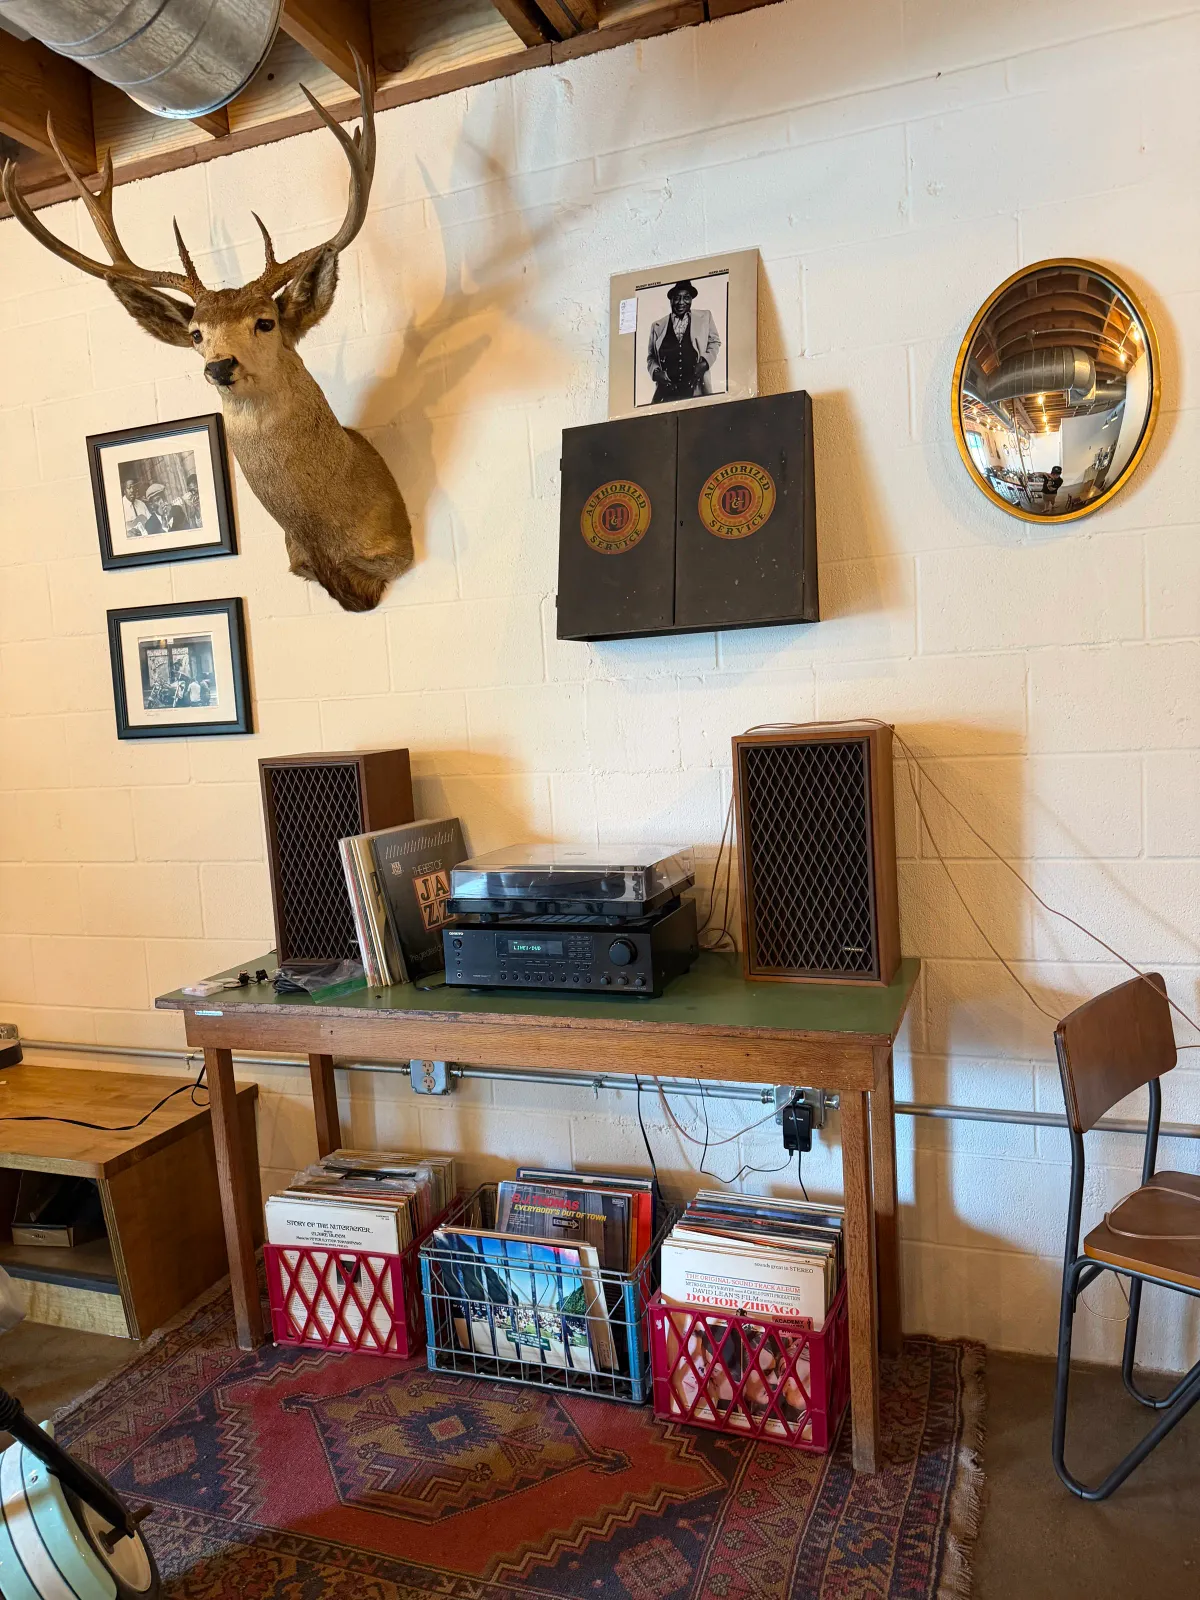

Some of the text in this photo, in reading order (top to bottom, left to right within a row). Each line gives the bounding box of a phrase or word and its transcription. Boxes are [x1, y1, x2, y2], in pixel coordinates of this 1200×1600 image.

[704, 465, 770, 500] AUTHORIZED
[586, 484, 647, 517] AUTHORIZED
[709, 513, 767, 535] SERVICE
[590, 529, 641, 551] SERVICE
[532, 1195, 580, 1211] THOMAS
[514, 1204, 560, 1216] EVERYBODY'S
[587, 1213, 607, 1222] TOWN
[789, 1266, 814, 1274] STEREO
[700, 1275, 730, 1284] ORIGINAL
[754, 1282, 775, 1291] TRACK
[776, 1285, 801, 1294] ALBUM
[686, 1292, 800, 1316] DOCTOR ZHIVAGO
[692, 1287, 714, 1295] DAVID
[714, 1290, 740, 1300] LEAN'S
[741, 1294, 759, 1302] FILM
[774, 1293, 801, 1301] PRODUCTION
